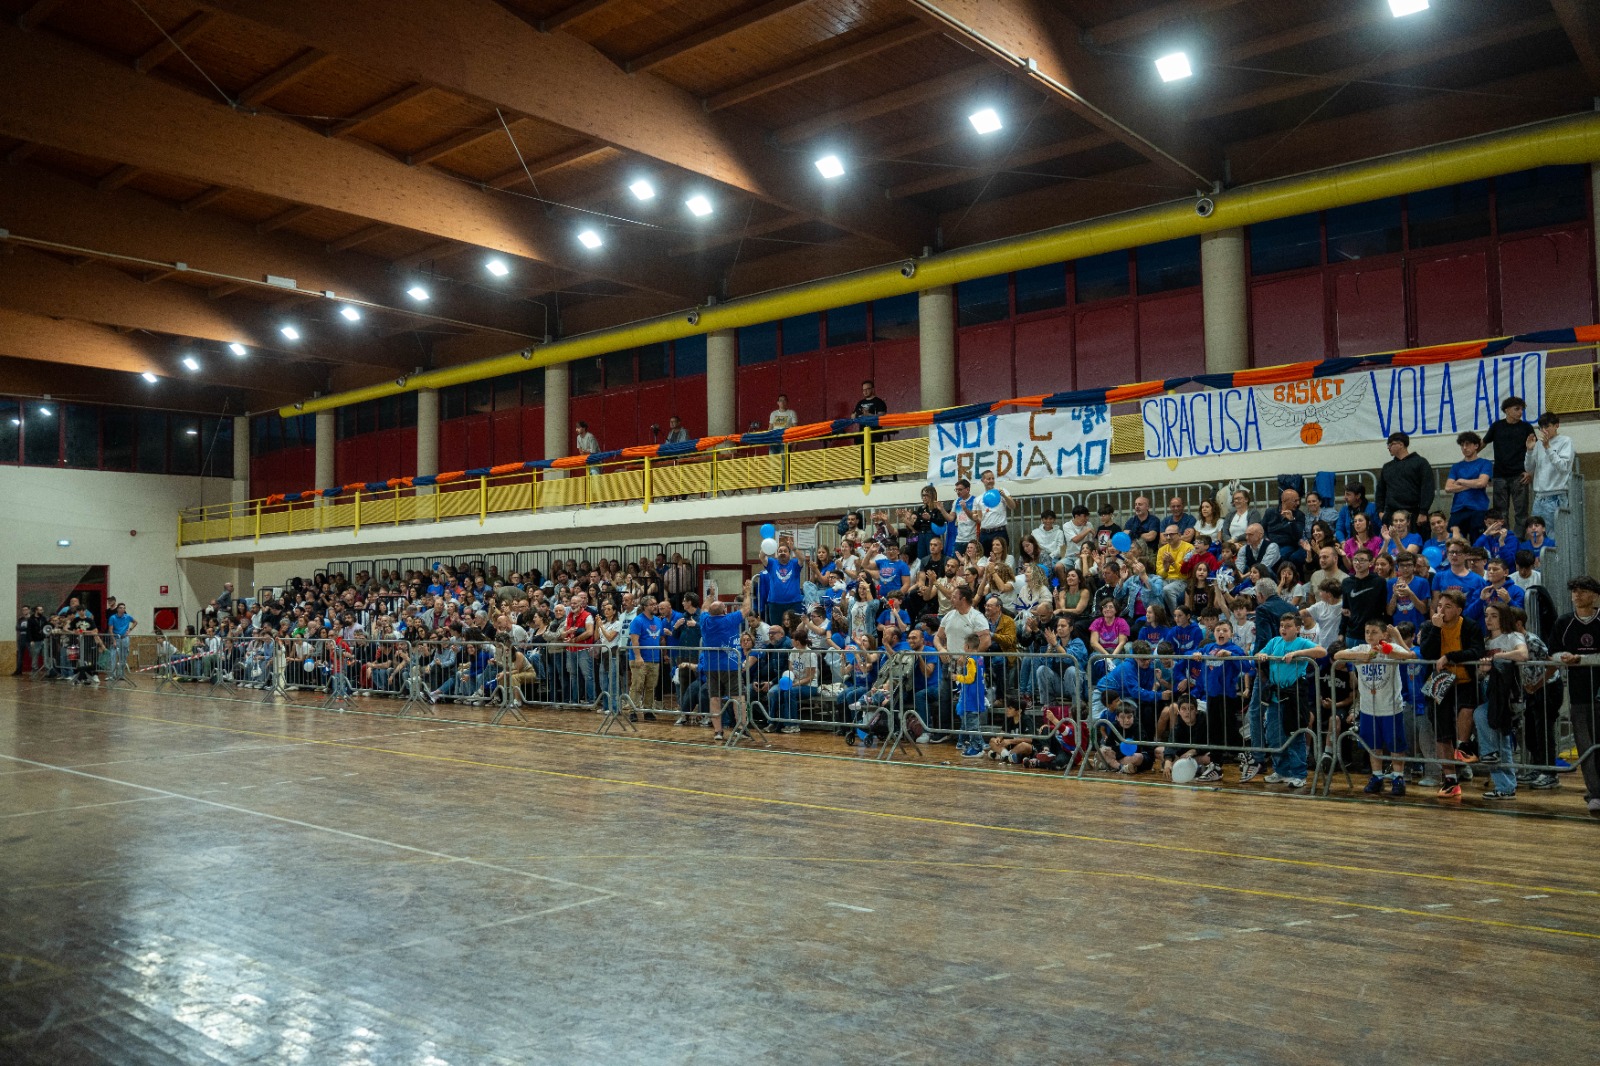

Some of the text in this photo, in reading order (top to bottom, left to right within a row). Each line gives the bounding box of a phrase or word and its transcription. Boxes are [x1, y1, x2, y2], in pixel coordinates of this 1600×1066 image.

[936, 408, 1056, 450] NOI C
[1143, 387, 1262, 458] SIRACUSA
[1273, 378, 1345, 404] BASKET
[1370, 363, 1457, 438] VOLA
